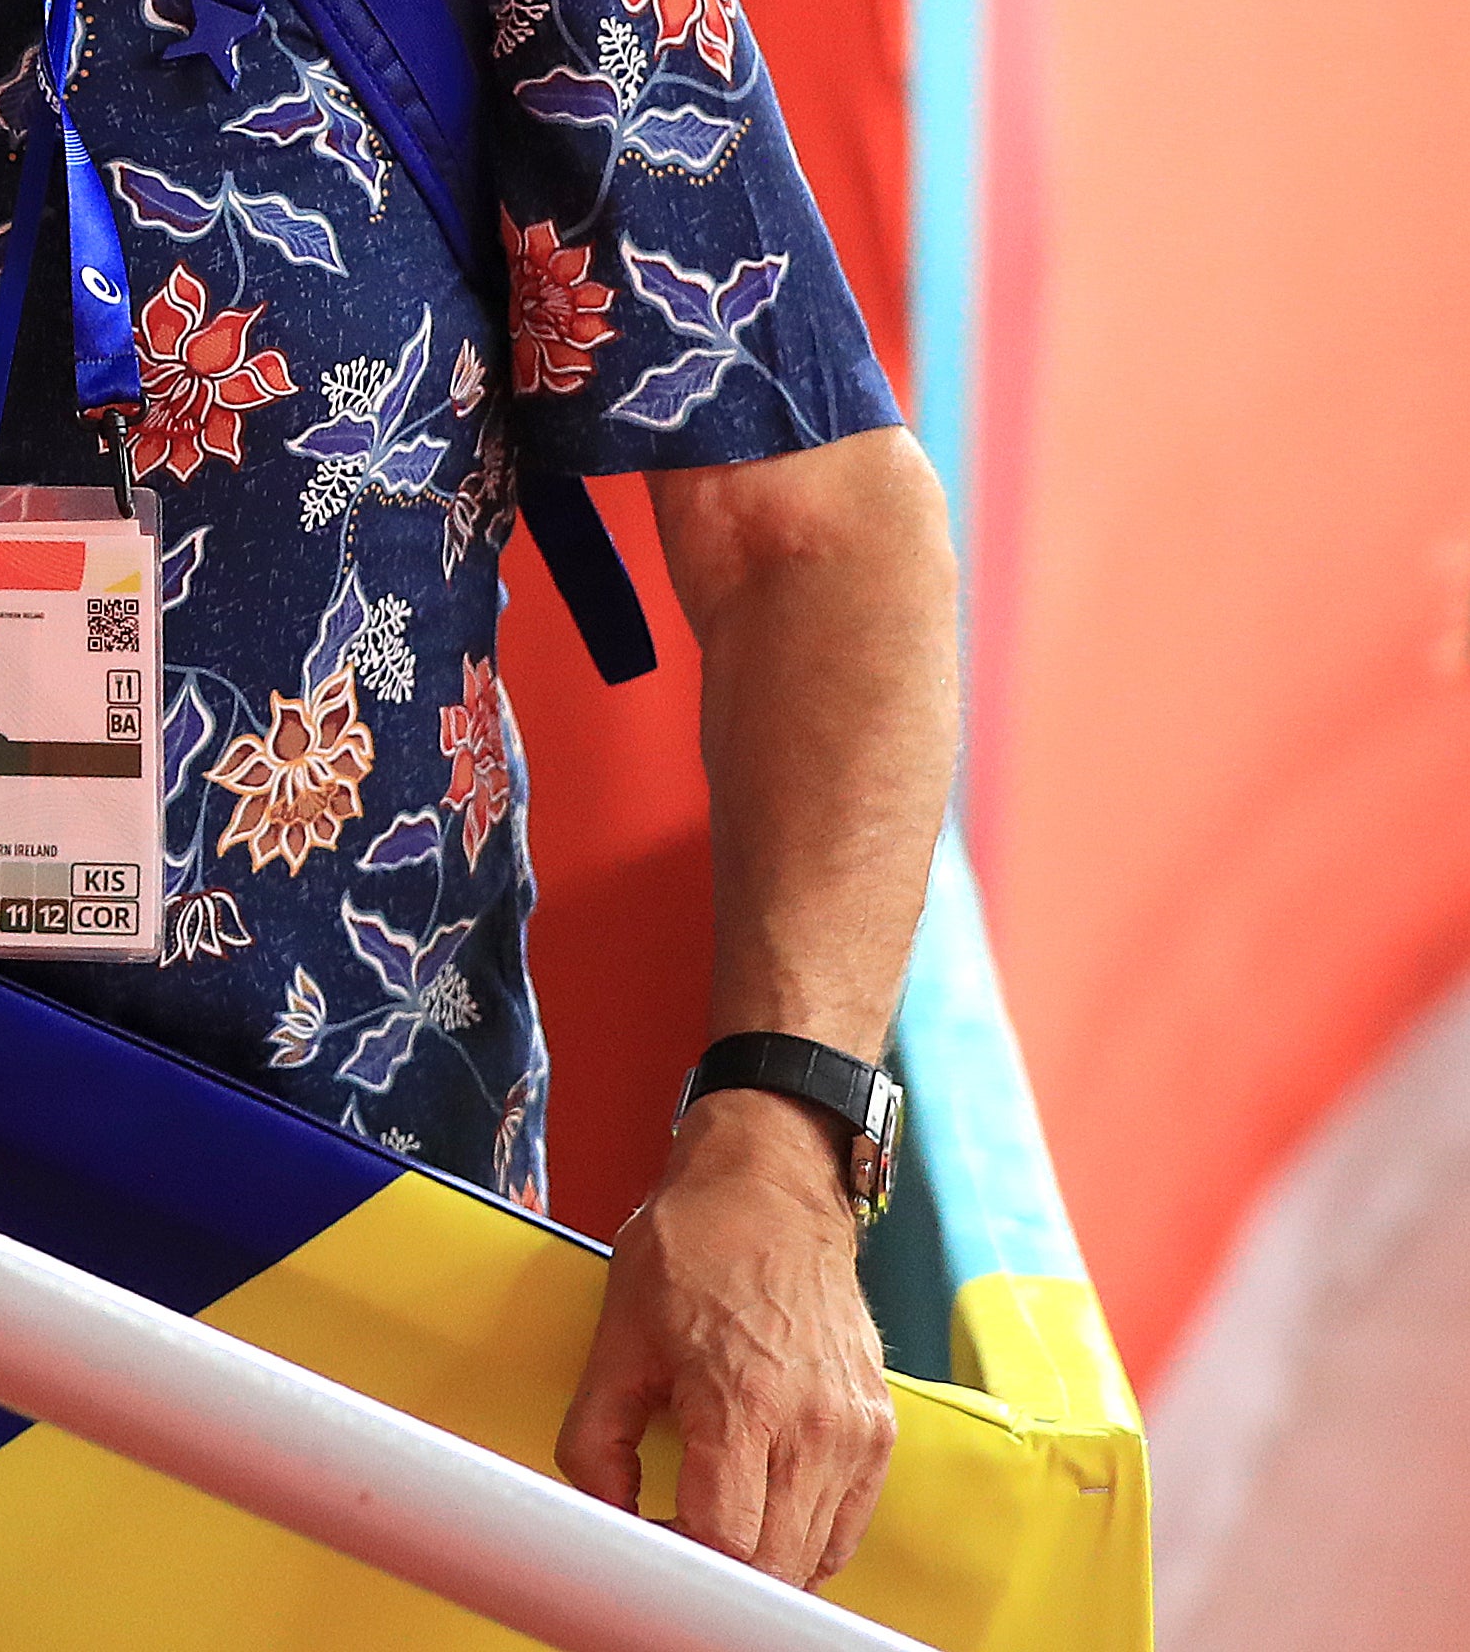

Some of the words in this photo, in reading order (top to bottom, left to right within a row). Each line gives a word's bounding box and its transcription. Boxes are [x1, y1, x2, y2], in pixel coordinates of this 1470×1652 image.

[110, 713, 137, 734] BA
[13, 843, 59, 858] IRELAND
[84, 869, 126, 893] KIS
[5, 903, 29, 928] 11
[38, 904, 65, 929] 12
[76, 905, 131, 930] COR
